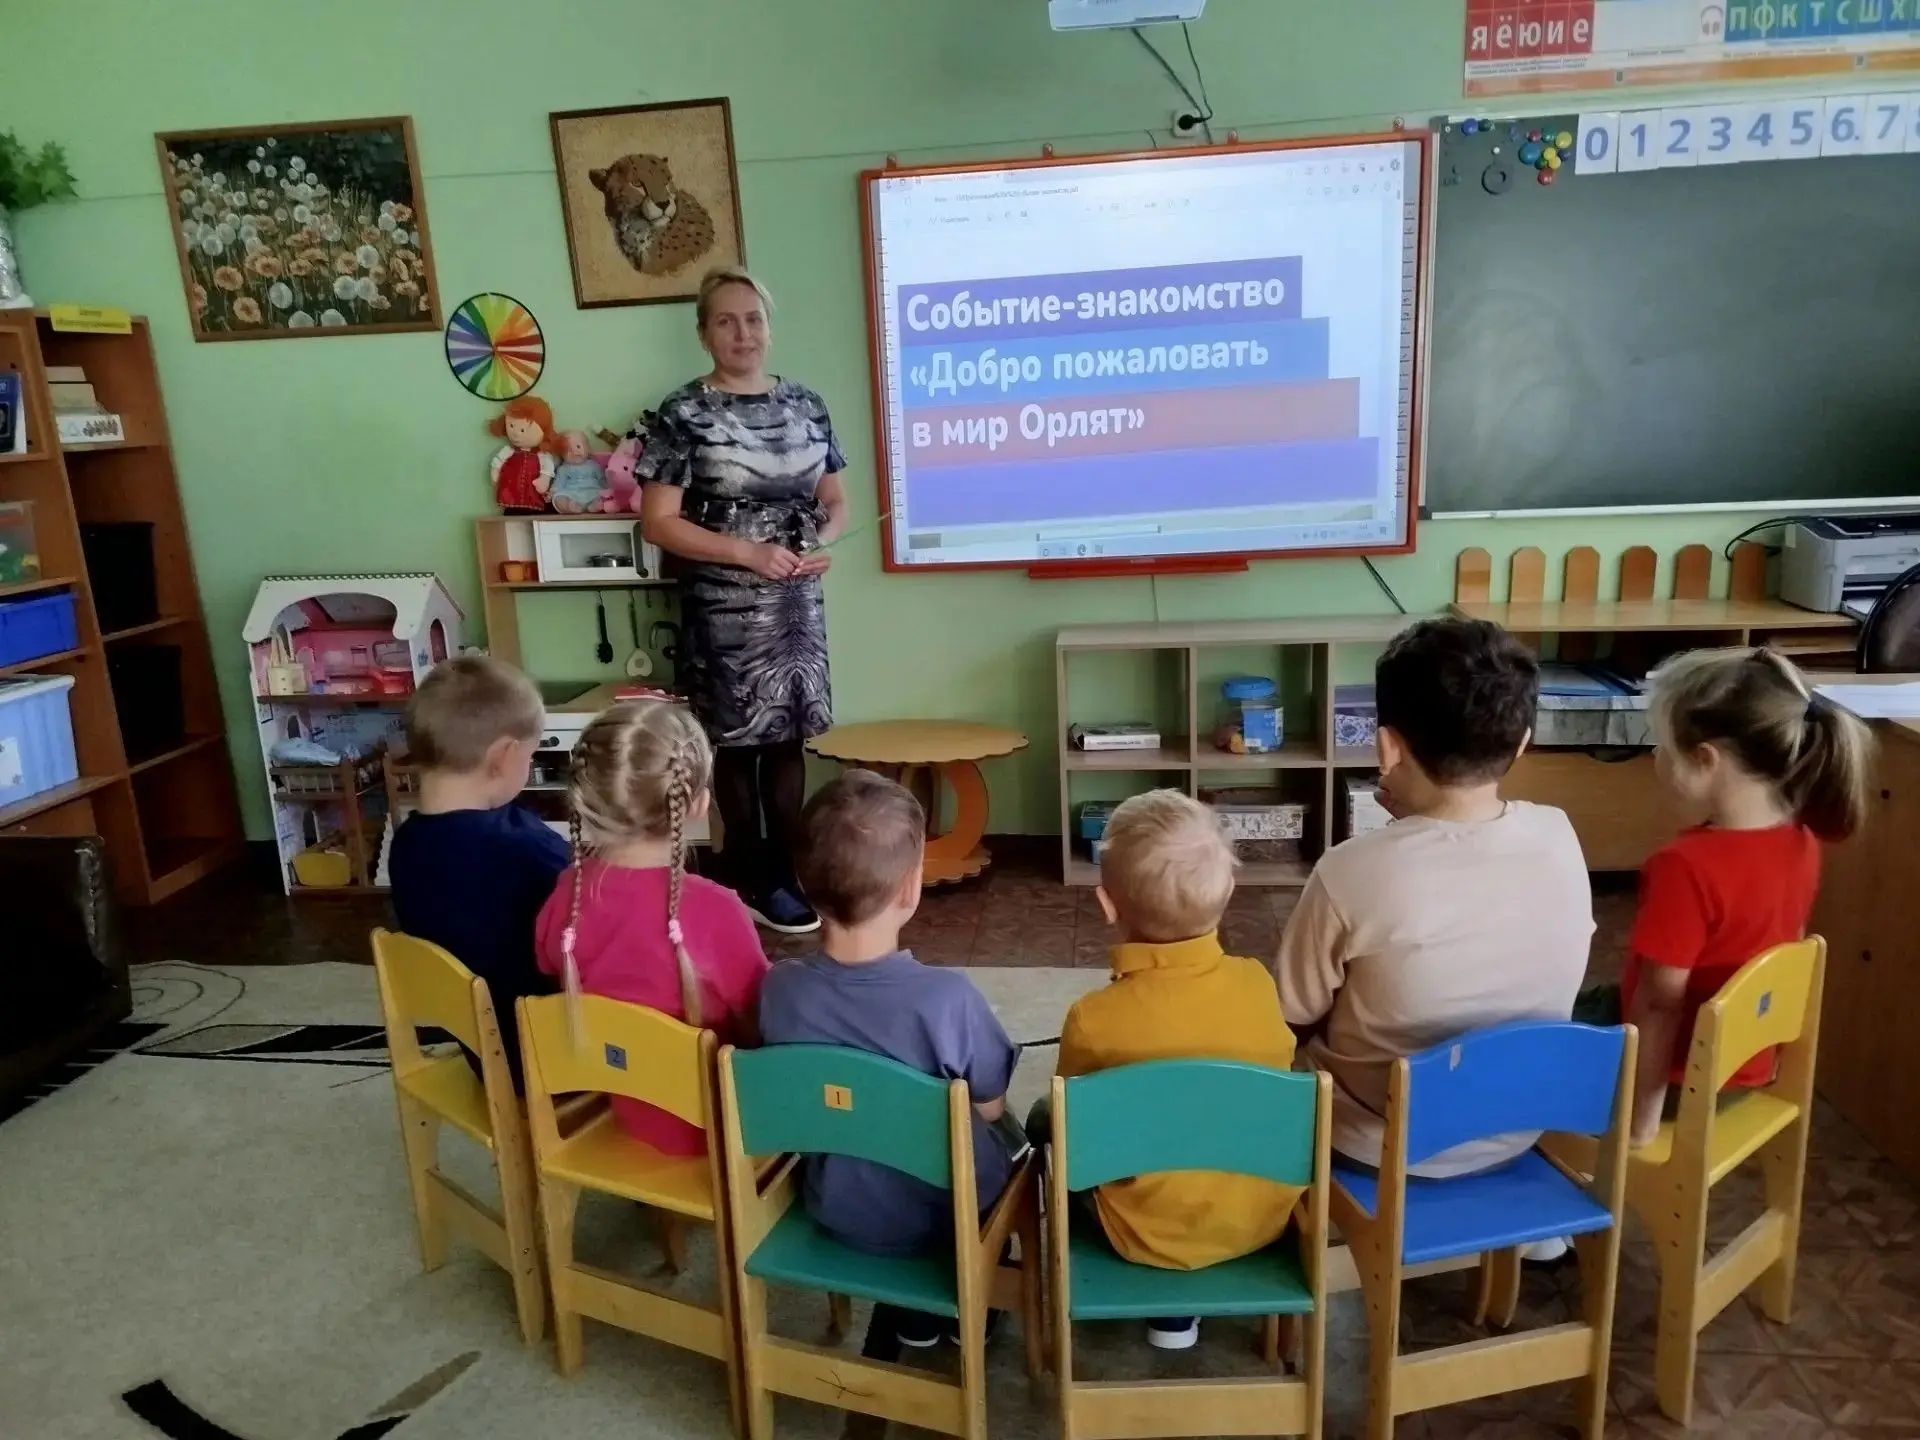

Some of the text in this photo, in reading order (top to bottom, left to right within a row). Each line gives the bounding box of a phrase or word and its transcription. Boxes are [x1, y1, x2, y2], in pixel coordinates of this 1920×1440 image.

[1585, 126, 1609, 161] 0
[1630, 124, 1646, 157] 1
[1666, 119, 1691, 154] 2
[1707, 116, 1732, 151] 3
[1747, 112, 1773, 147] 4
[1790, 110, 1814, 145] 5
[1877, 104, 1900, 140] 7
[907, 278, 1285, 332] Событие-знакомство
[910, 340, 1269, 398] «Добро пожаловать
[912, 403, 1145, 452] в мир Орлят»
